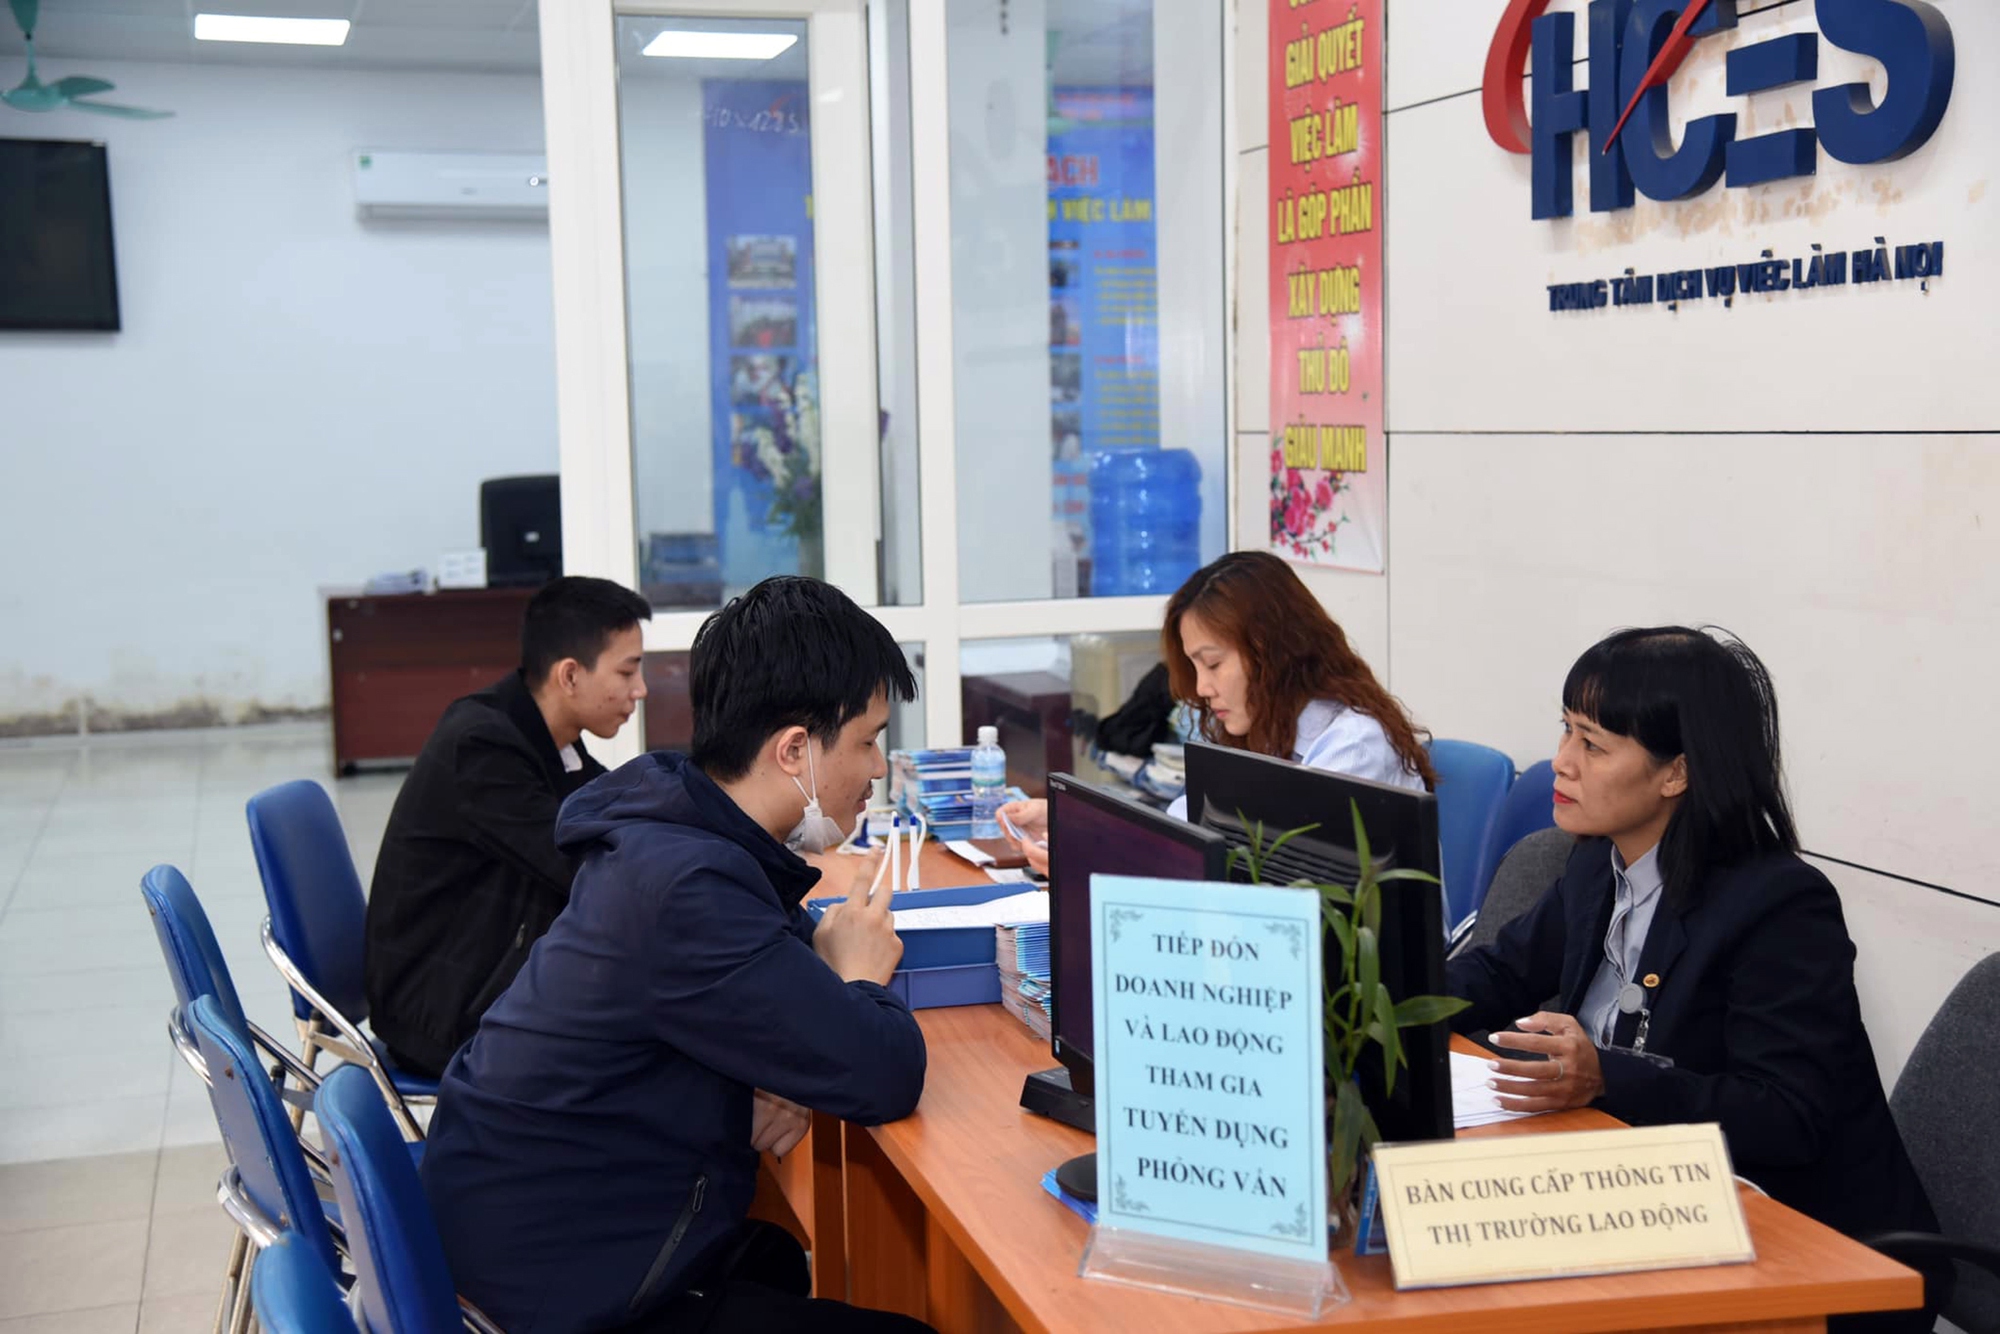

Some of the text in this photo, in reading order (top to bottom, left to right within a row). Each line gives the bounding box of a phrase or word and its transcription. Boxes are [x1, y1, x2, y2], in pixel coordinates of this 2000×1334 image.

[1285, 3, 1364, 90] GIẢI QUYẾT
[1290, 96, 1358, 173] VIỆC LÀM
[1277, 166, 1372, 245] LÀ GÓP PHẦN
[1287, 262, 1360, 327] XÂY DỰNG
[1547, 279, 1608, 311] TRUNG
[1609, 267, 1654, 306] TÂM
[1656, 269, 1703, 312] DỊCH
[1705, 266, 1737, 308] VỤ
[1792, 243, 1847, 289] LÀM
[1852, 236, 1893, 284] HÀ
[1297, 331, 1325, 395] THỦ
[1284, 413, 1367, 481] GIÀU MẠNH
[1152, 931, 1204, 956] TIẾP
[1115, 973, 1293, 1013] DOANH NGHIỆP
[1125, 1015, 1284, 1055] VÀ LAO ĐỘNG
[1146, 1065, 1263, 1098] THAM GIA
[1123, 1106, 1289, 1149] TUYỂN DỤNG
[1137, 1156, 1225, 1190] PHỎNG
[1405, 1180, 1455, 1205] BÀN
[1461, 1176, 1525, 1200] CUNG
[1531, 1167, 1574, 1196] CẤP
[1580, 1164, 1664, 1190] THÔNG
[1669, 1162, 1711, 1182] TIN
[1428, 1203, 1709, 1247] THỊ TRƯỜNG LAO ĐỘNG
